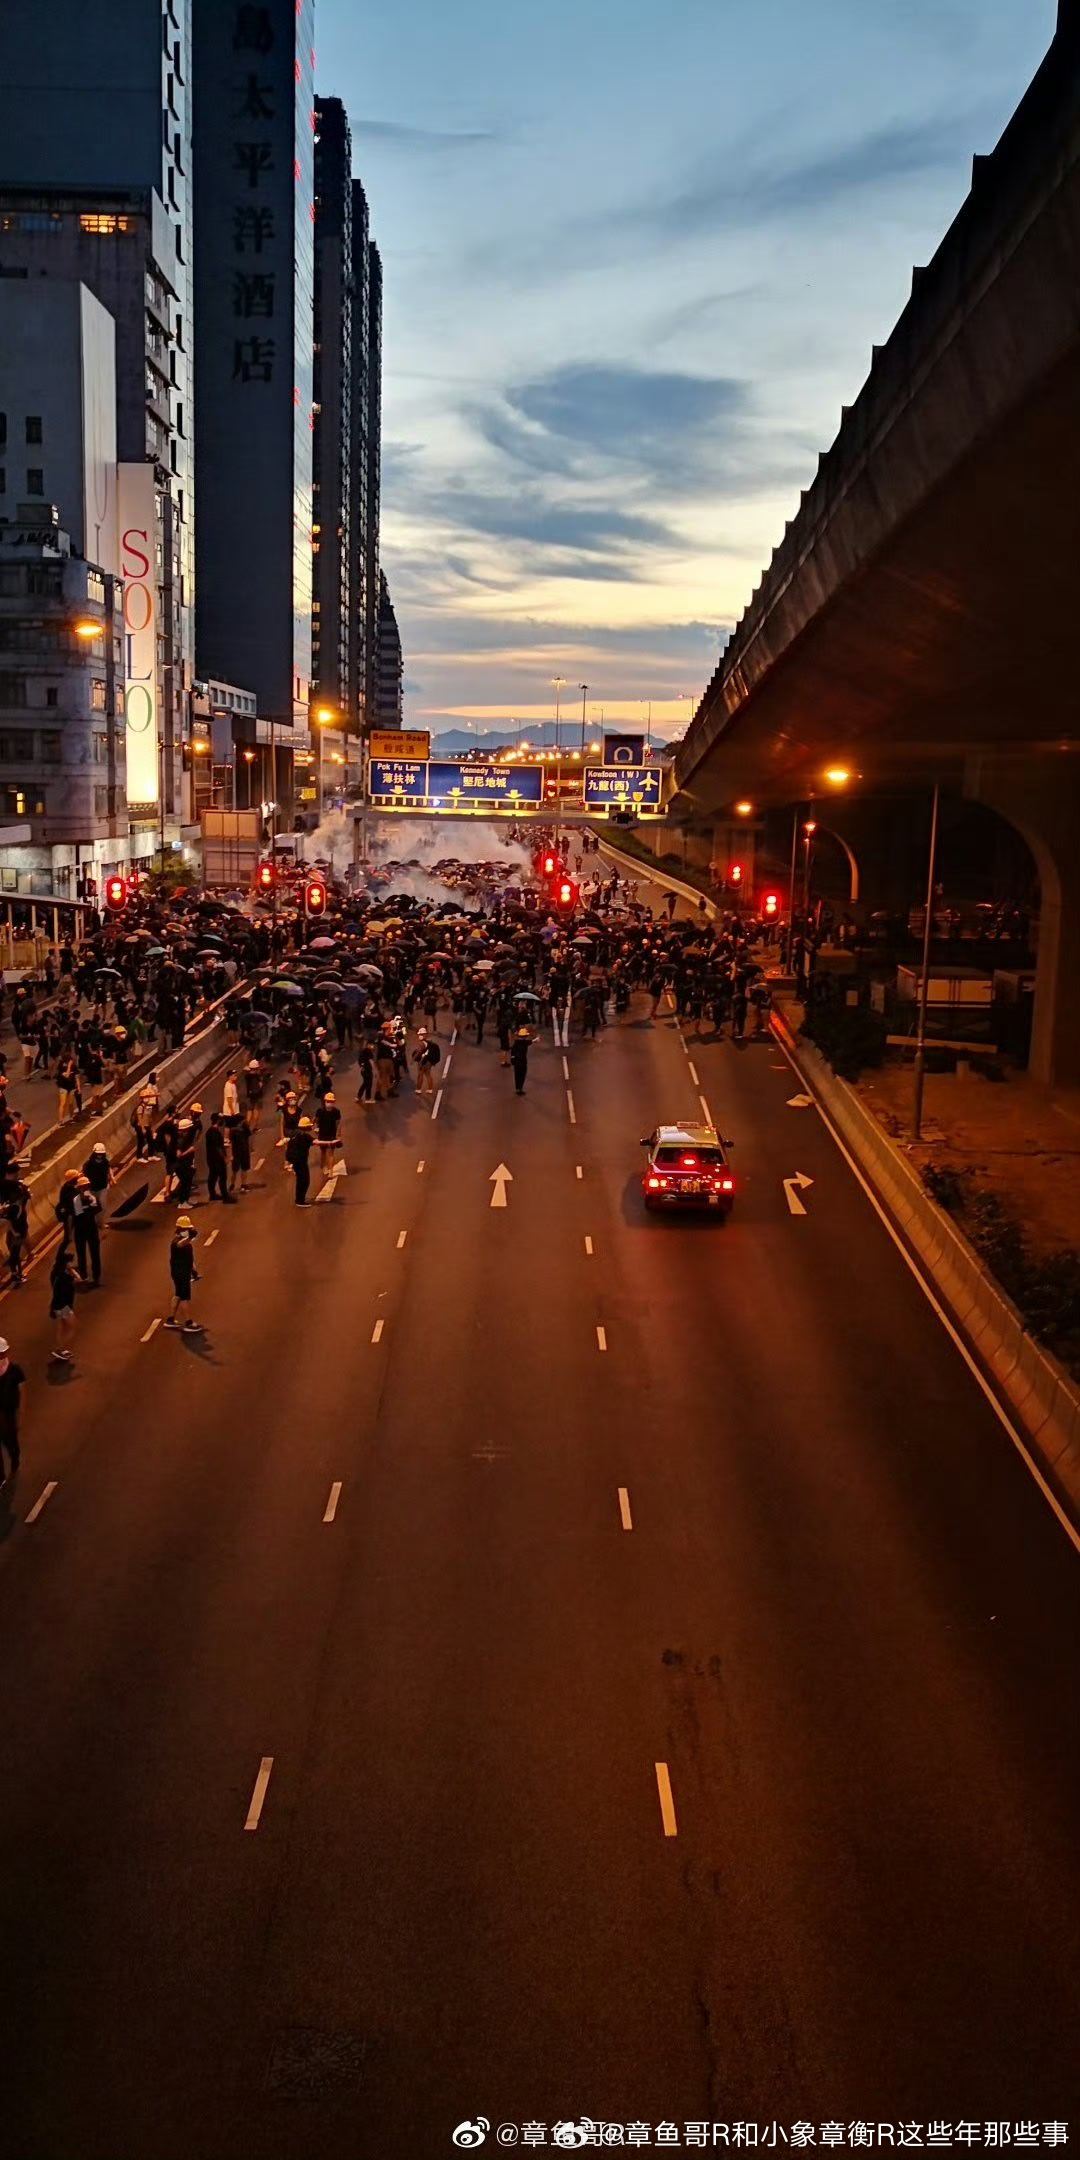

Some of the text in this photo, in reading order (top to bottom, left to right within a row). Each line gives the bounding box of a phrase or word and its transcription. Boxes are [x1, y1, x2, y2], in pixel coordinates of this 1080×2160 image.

[122, 529, 152, 732] SOLO
[406, 734, 426, 742] Road
[377, 762, 421, 772] Pok Fu Lam
[459, 766, 511, 776] Kennedy Town
[382, 773, 416, 785] 薄扶林
[588, 770, 617, 778] Kowloon
